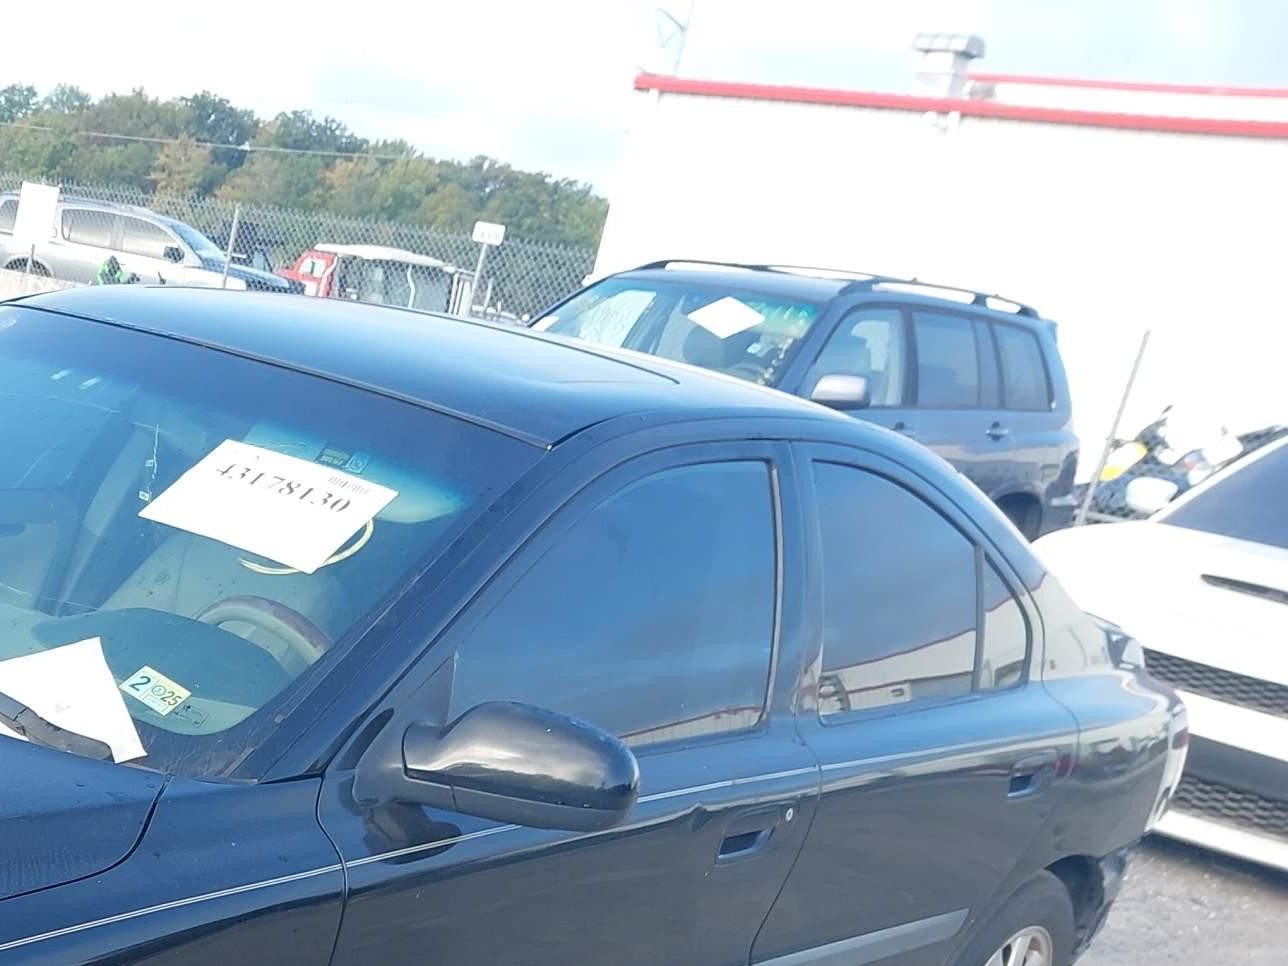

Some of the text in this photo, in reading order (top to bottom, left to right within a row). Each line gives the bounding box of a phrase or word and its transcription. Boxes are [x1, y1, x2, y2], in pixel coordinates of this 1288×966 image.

[216, 463, 351, 512] 43178130
[128, 675, 183, 707] 2 25
